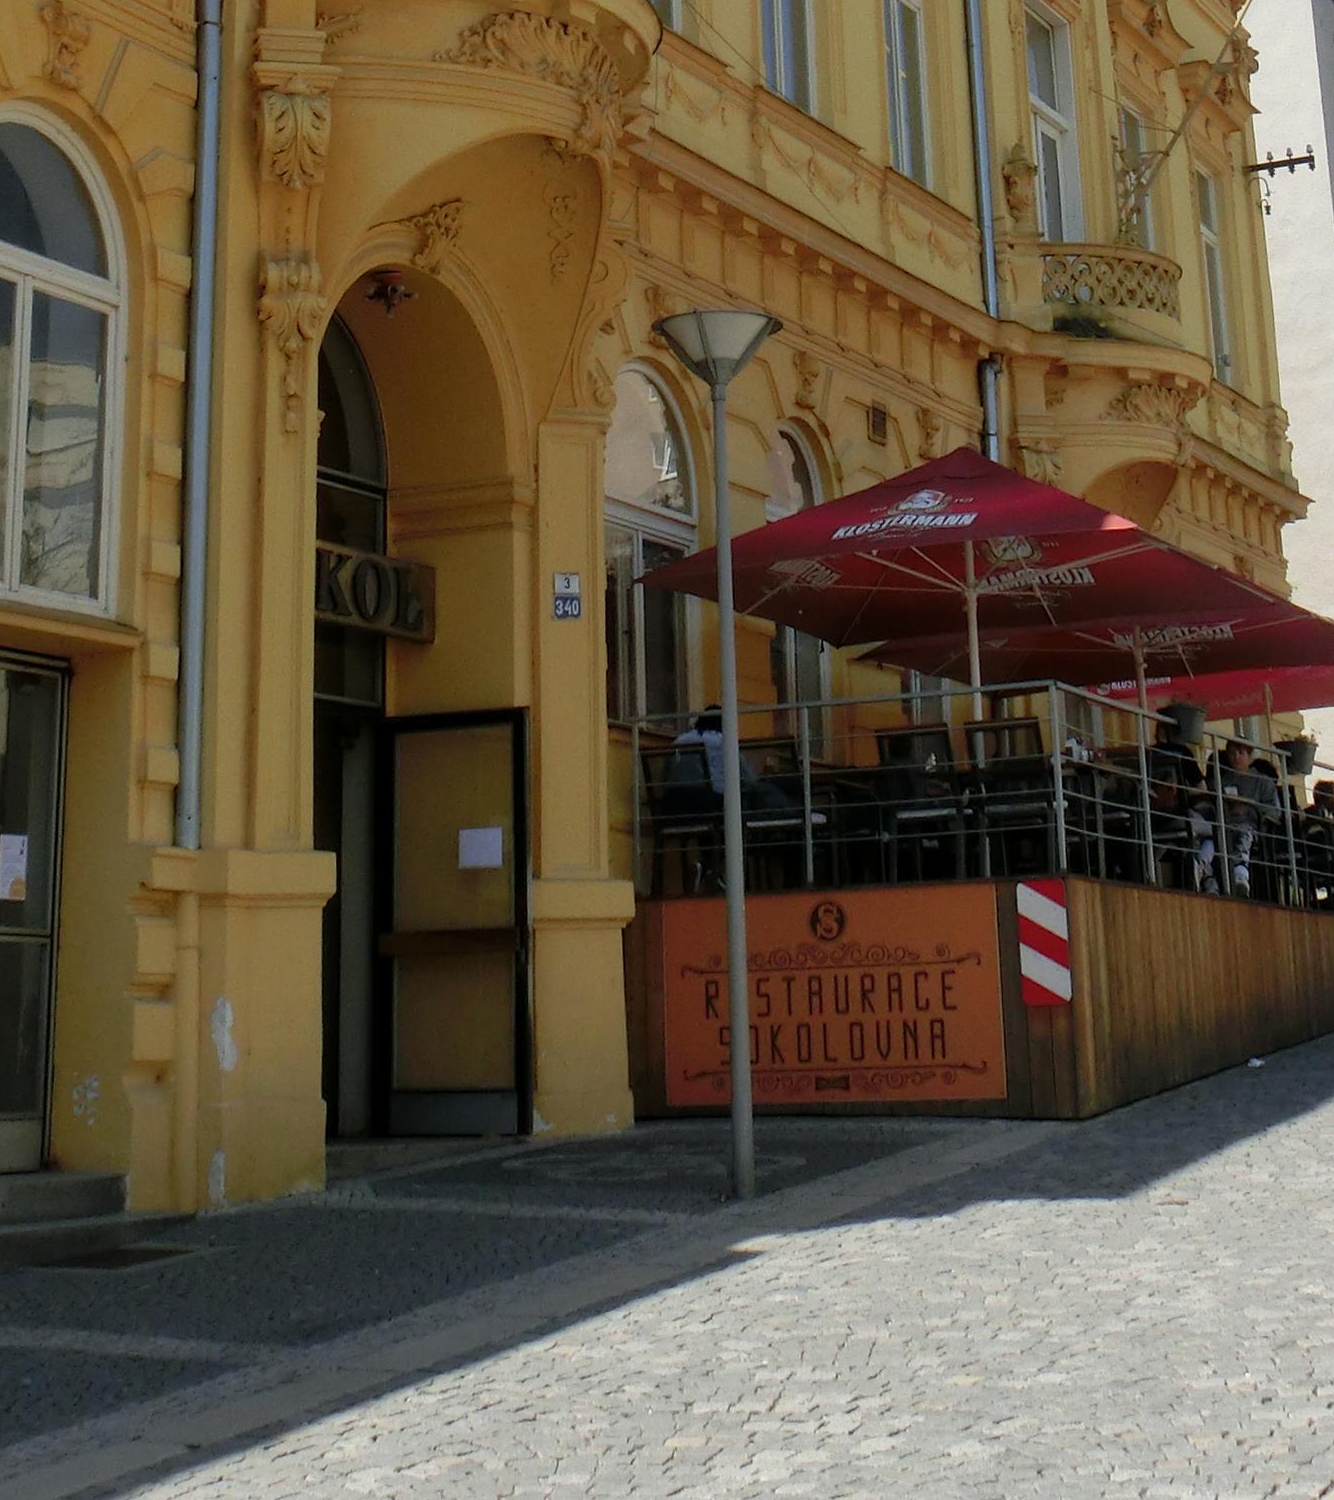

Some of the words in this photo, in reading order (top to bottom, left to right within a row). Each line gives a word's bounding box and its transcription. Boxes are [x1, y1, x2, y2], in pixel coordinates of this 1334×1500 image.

[831, 512, 979, 540] KLOSTERMANN
[564, 576, 571, 590] 3
[555, 599, 579, 616] 340
[705, 969, 958, 1020] RSTAURACE
